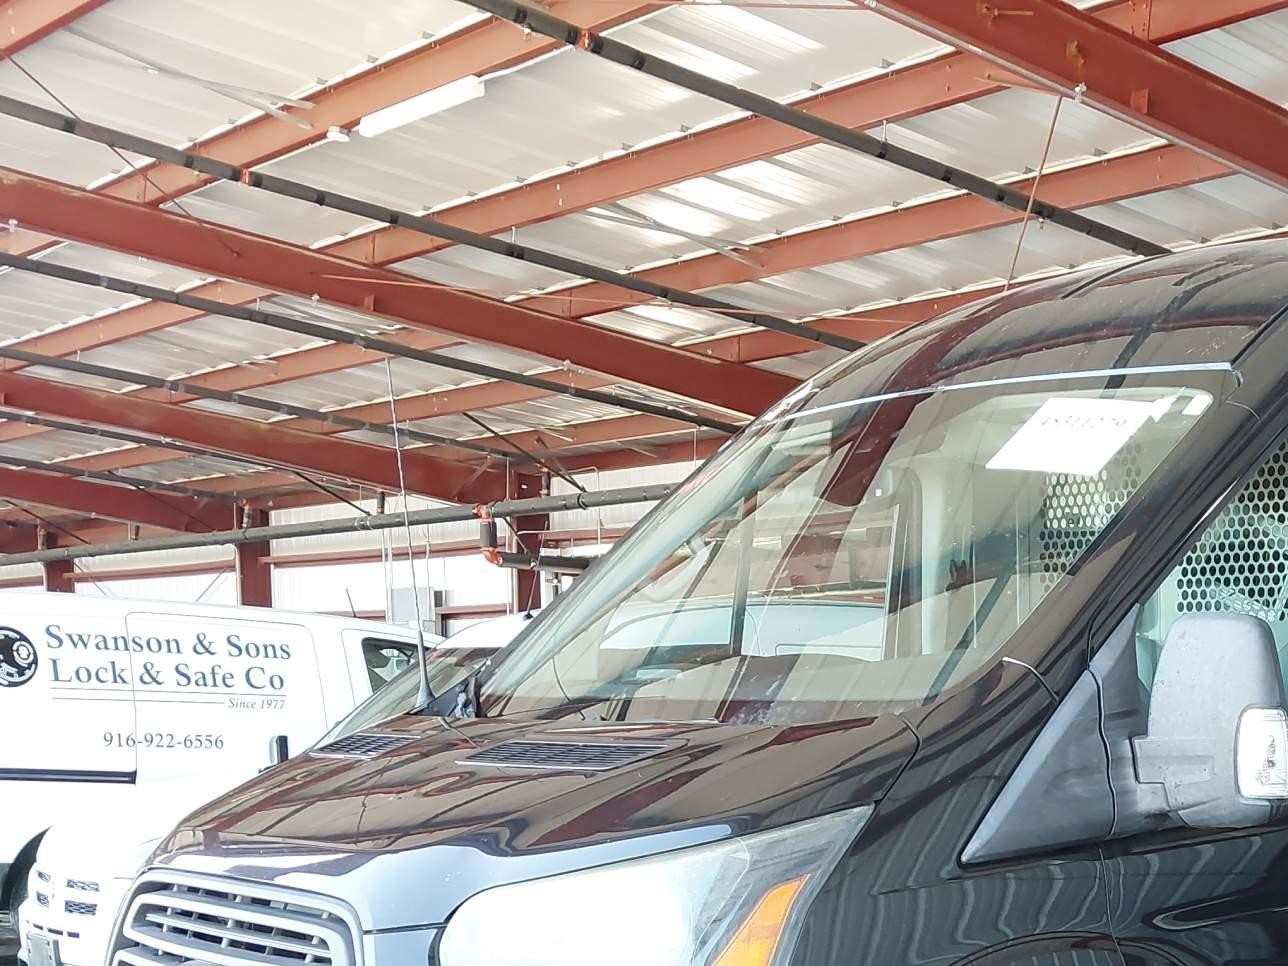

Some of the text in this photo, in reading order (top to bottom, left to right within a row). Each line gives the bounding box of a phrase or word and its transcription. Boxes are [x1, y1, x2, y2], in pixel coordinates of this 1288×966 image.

[46, 624, 292, 660] Swanson & Sons
[49, 658, 285, 690] Lock & Safe Co
[228, 697, 286, 710] Since 1977
[103, 732, 224, 749] 916-922-6556
